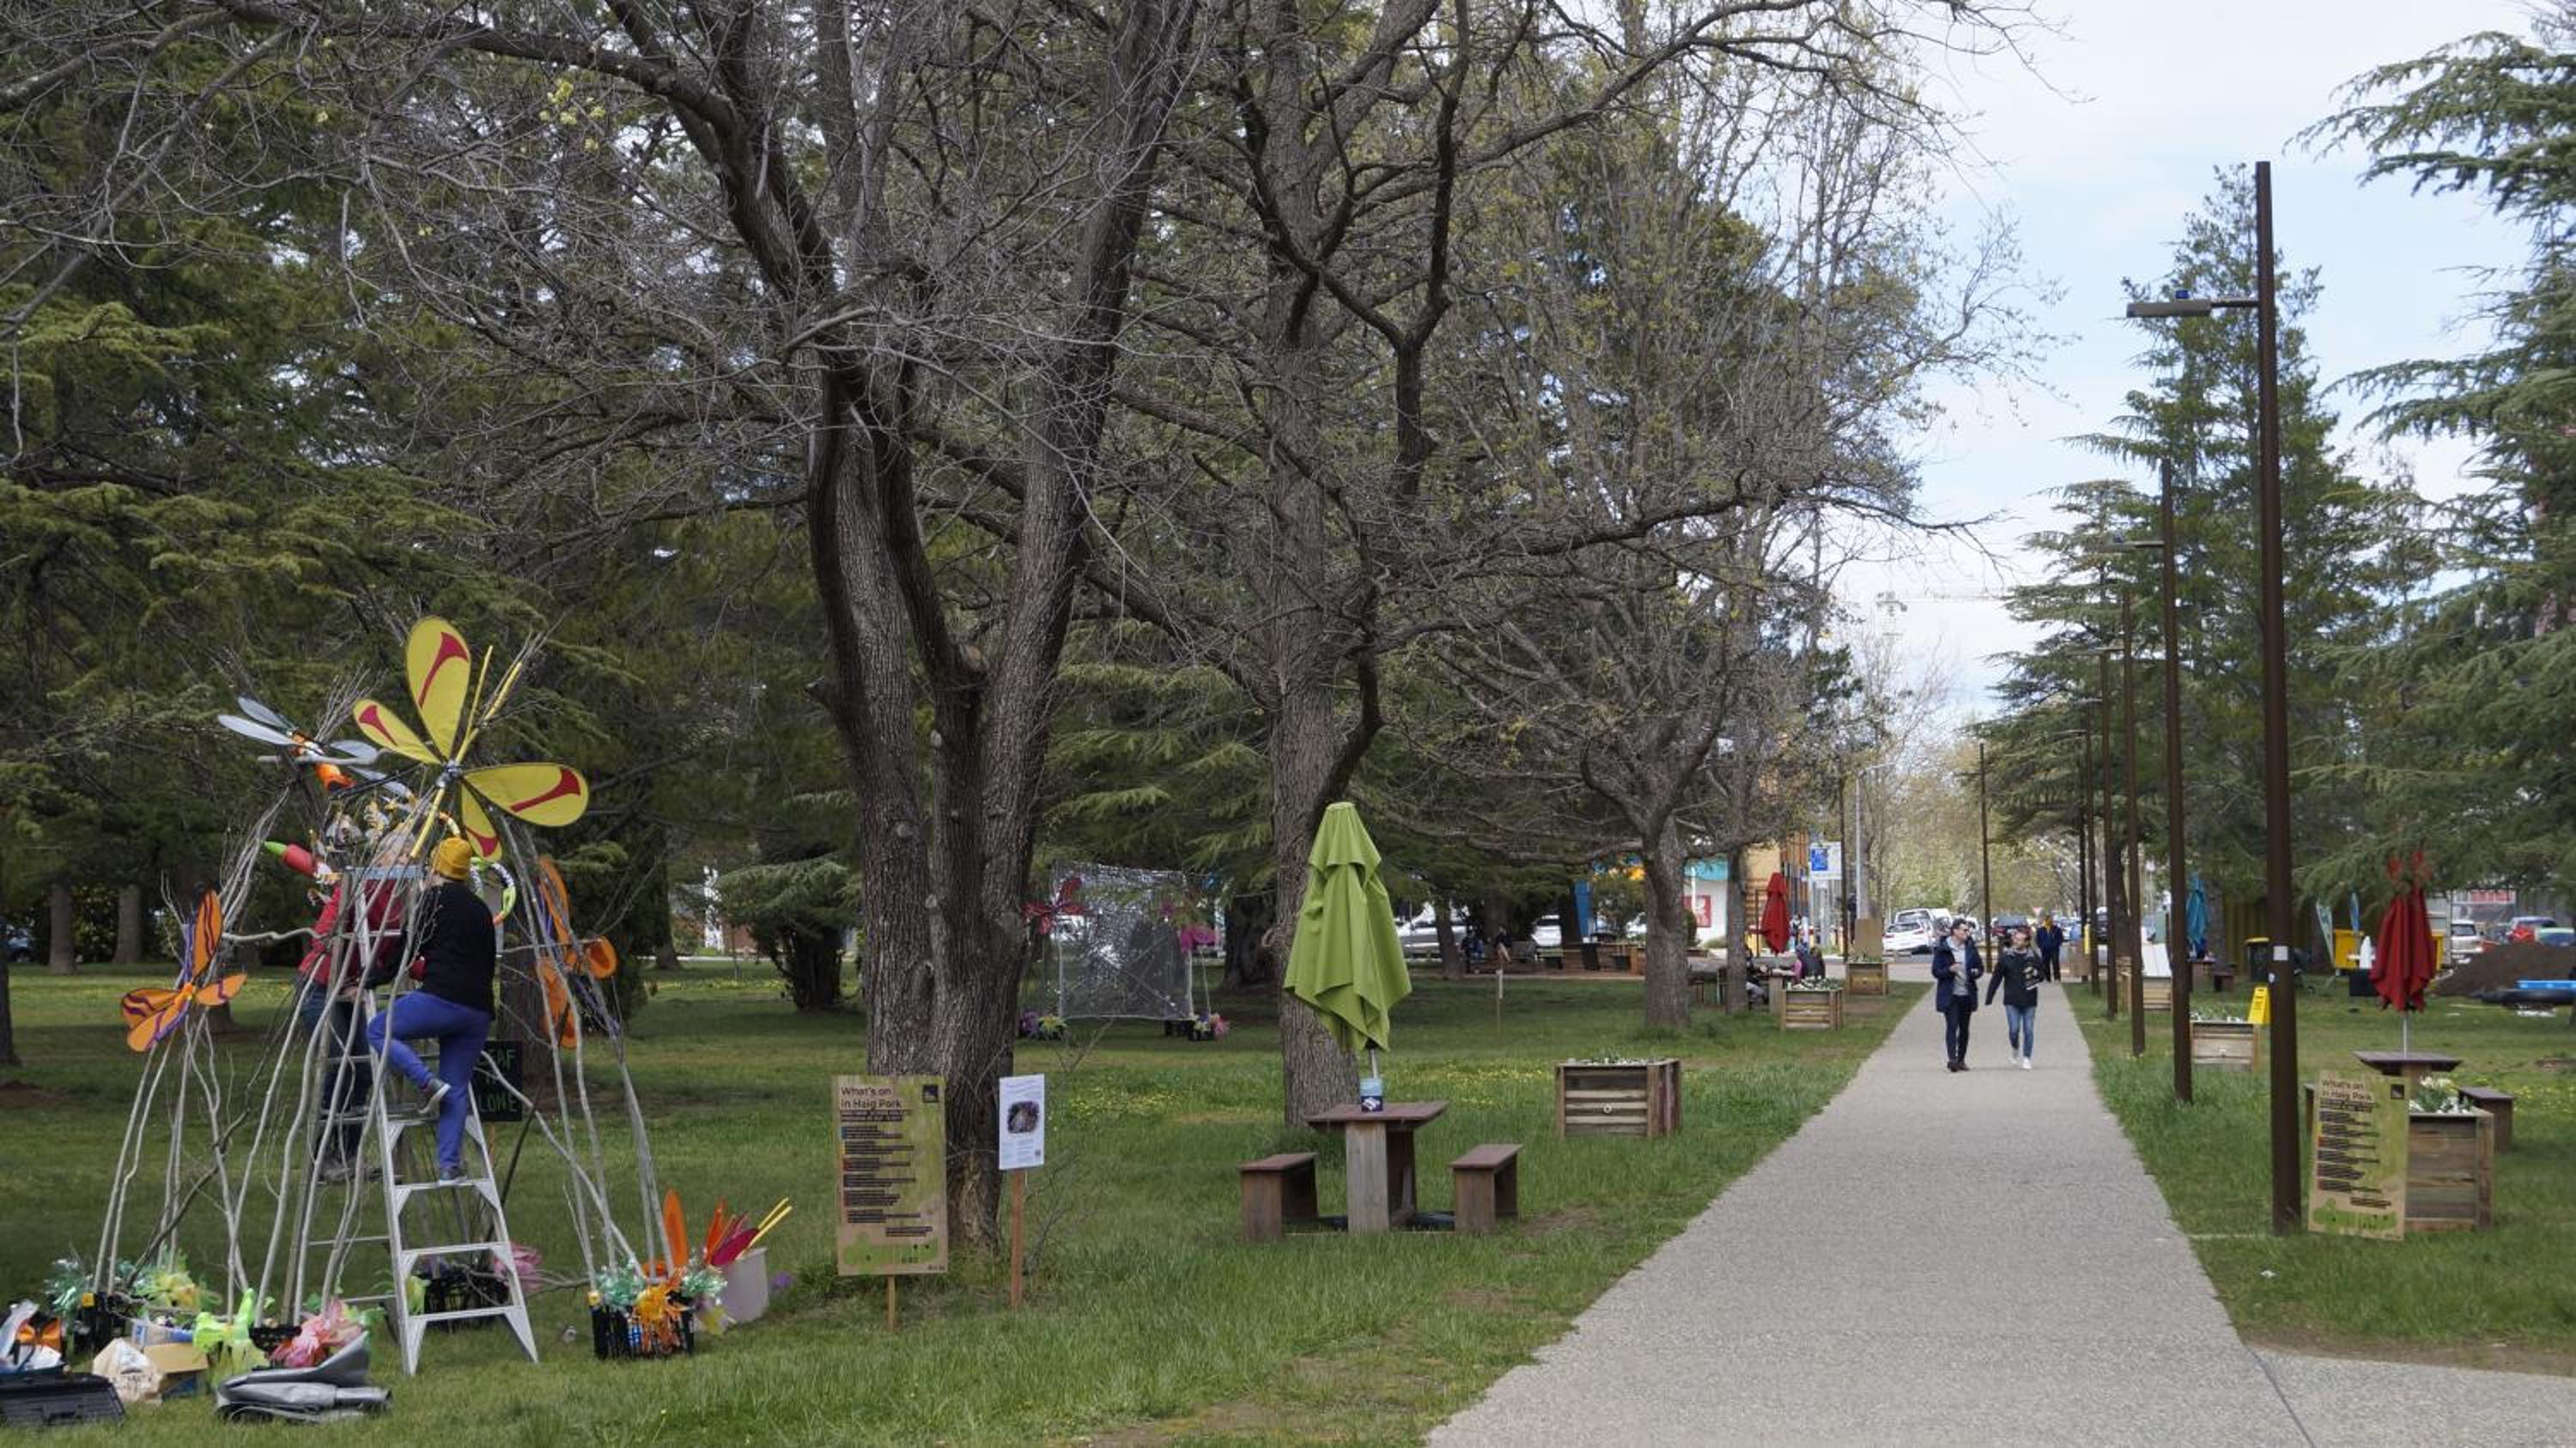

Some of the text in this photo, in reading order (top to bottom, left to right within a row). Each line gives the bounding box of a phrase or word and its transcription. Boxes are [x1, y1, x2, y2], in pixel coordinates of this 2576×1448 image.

[841, 1086, 892, 1097] What's on
[841, 1098, 851, 1109] in
